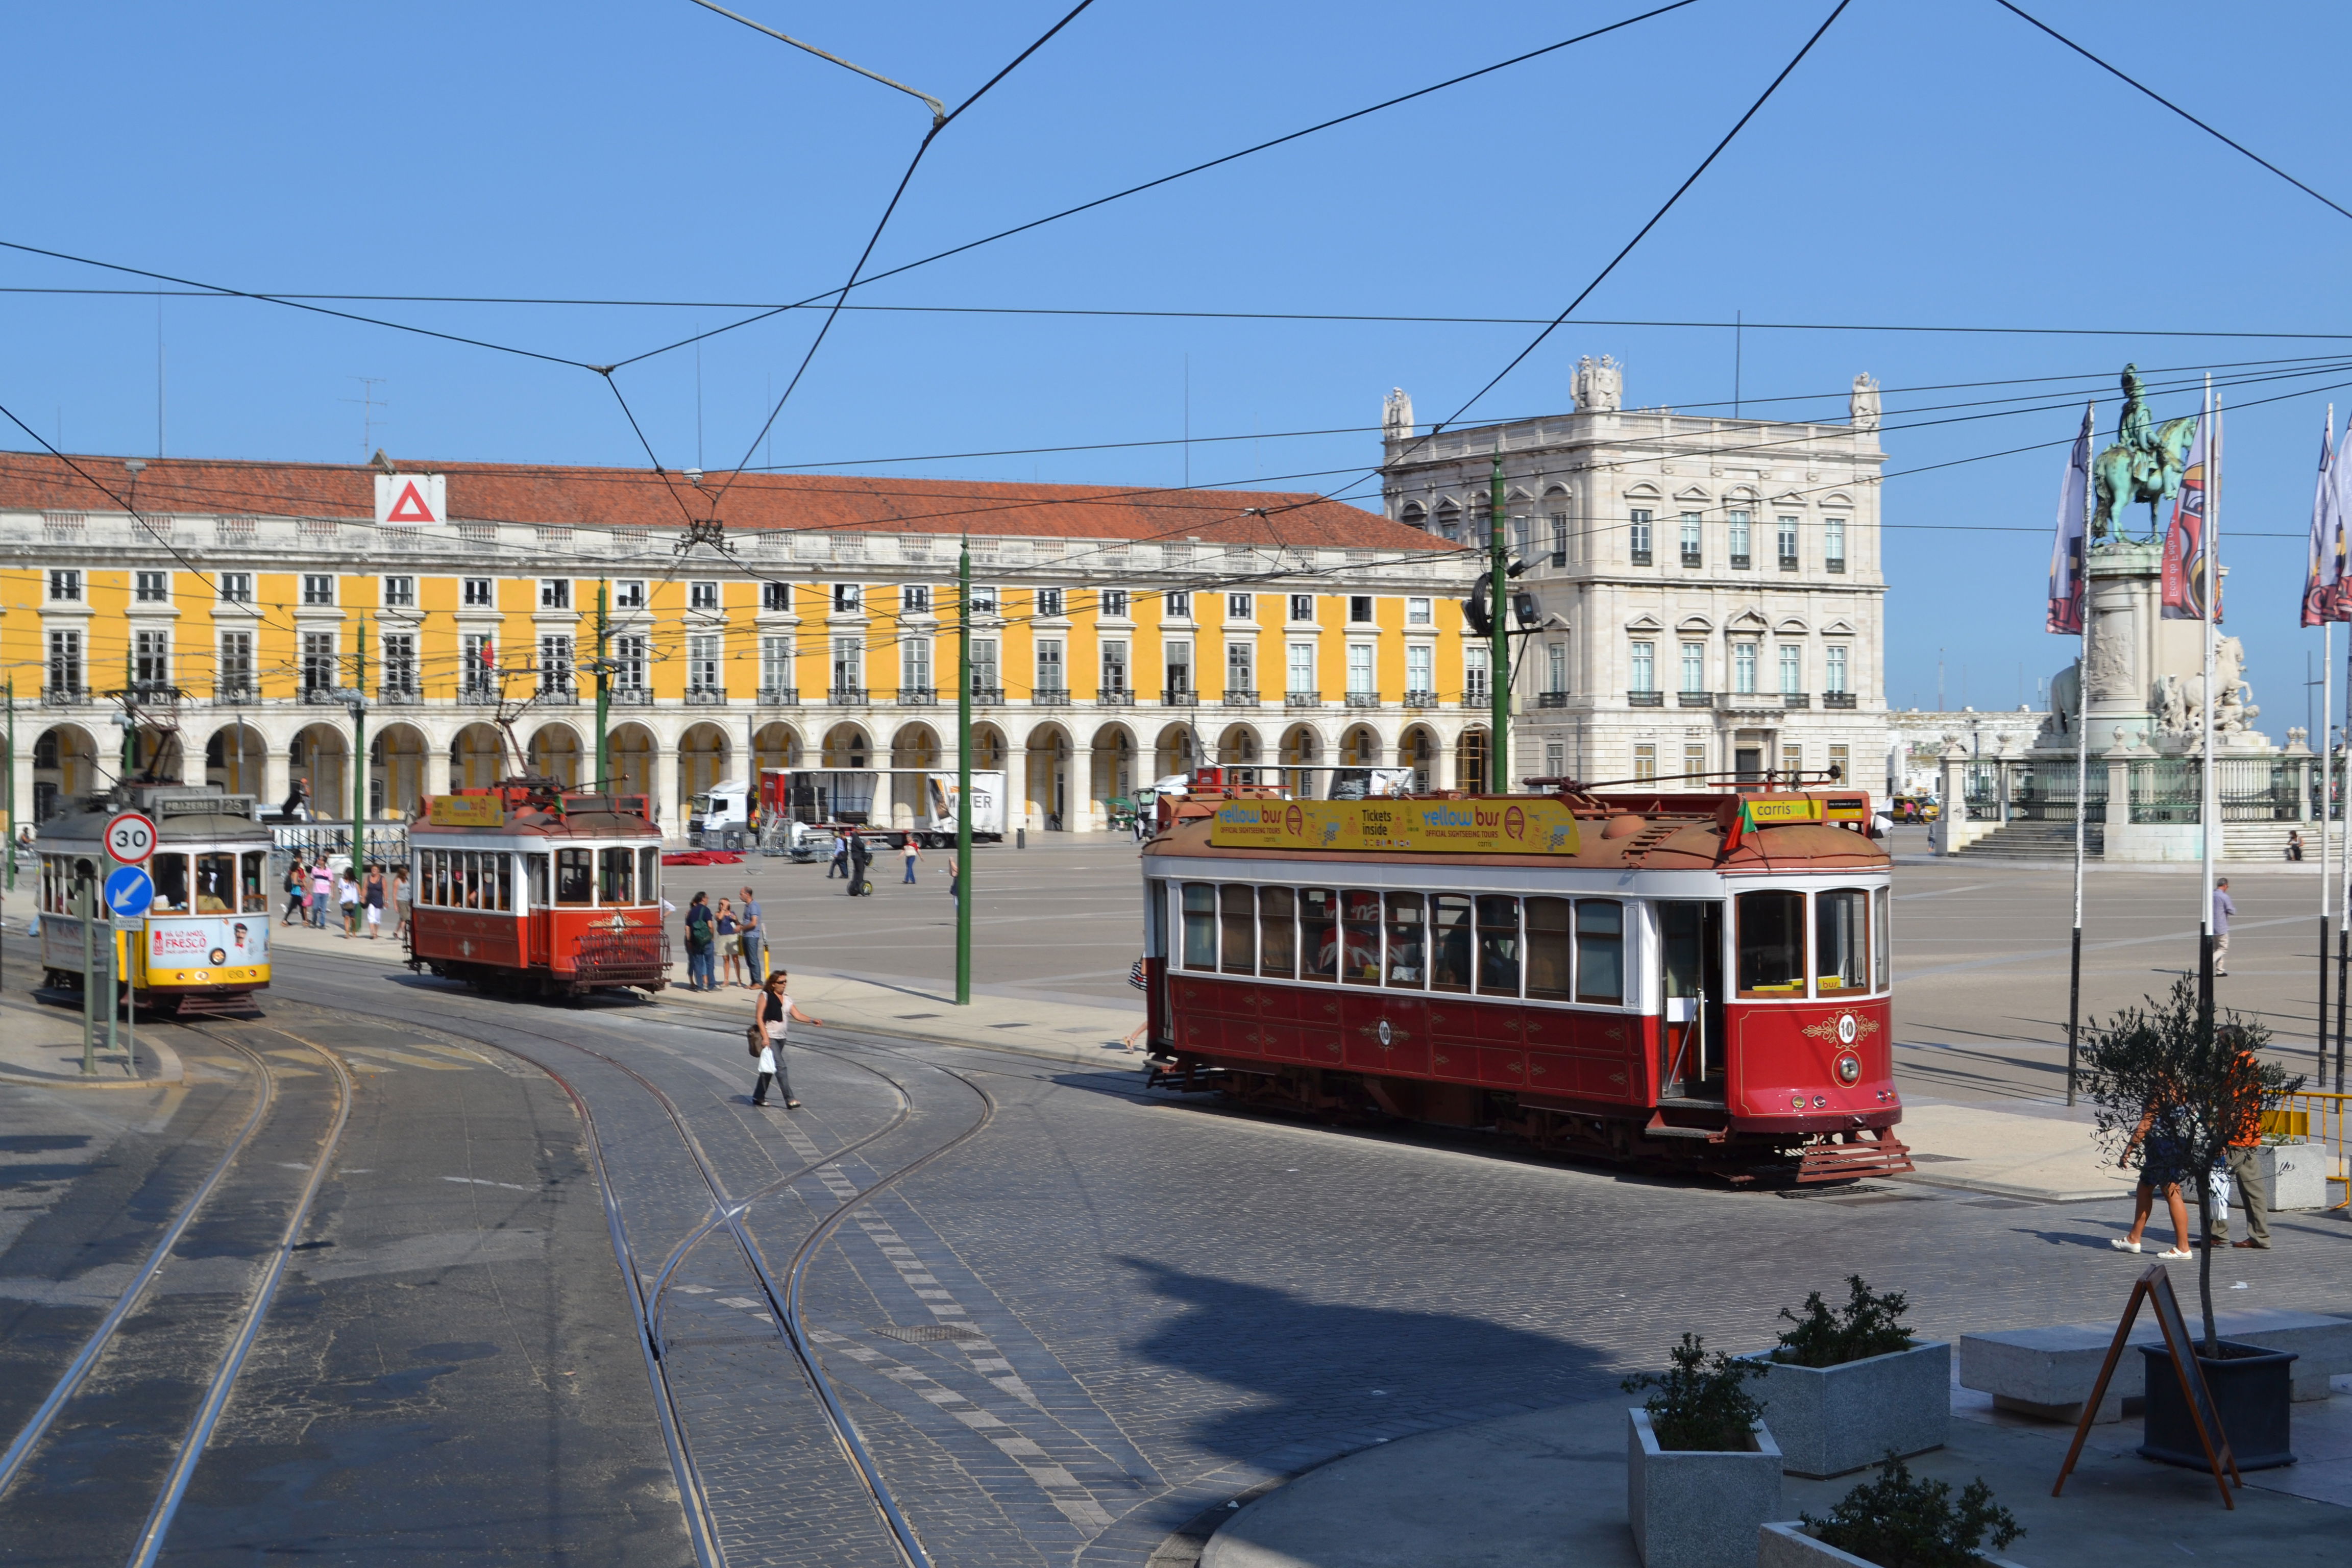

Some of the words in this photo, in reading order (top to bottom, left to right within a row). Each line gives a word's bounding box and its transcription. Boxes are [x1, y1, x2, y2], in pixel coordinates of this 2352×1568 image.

[165, 801, 217, 811] PRAZERES
[225, 799, 243, 811] 25
[1261, 804, 1282, 823] bus
[1362, 810, 1391, 822] Tickets
[1475, 805, 1500, 826] bus
[1362, 822, 1387, 836] inside
[1448, 830, 1480, 838] SIGHTSEEING
[115, 830, 146, 847] 30
[165, 937, 207, 948] FRESCO
[1823, 981, 1837, 989] bus
[1380, 1026, 1389, 1040] 10
[1841, 1021, 1854, 1038] 10
